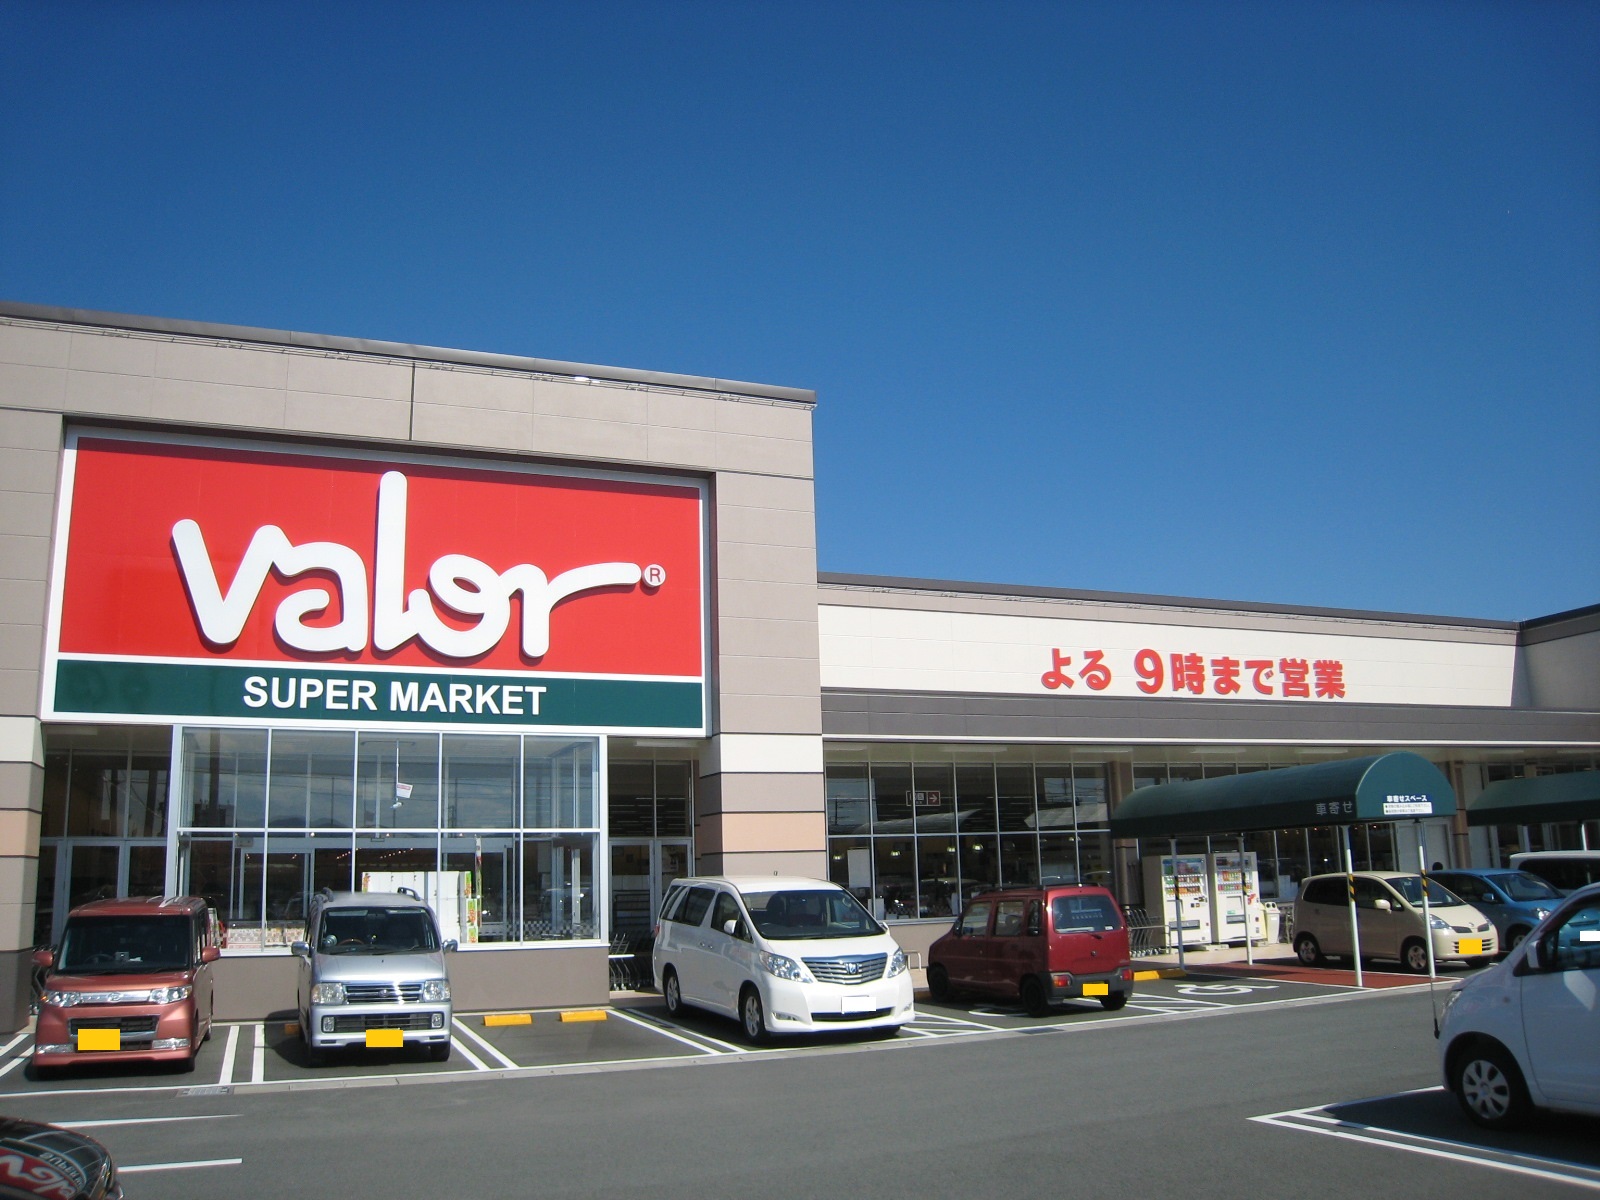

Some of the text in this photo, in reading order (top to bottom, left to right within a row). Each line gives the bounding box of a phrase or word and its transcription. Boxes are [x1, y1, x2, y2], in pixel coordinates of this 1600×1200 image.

[243, 675, 547, 716] SUPER MARKET
[1315, 800, 1353, 816] 車寄せ
